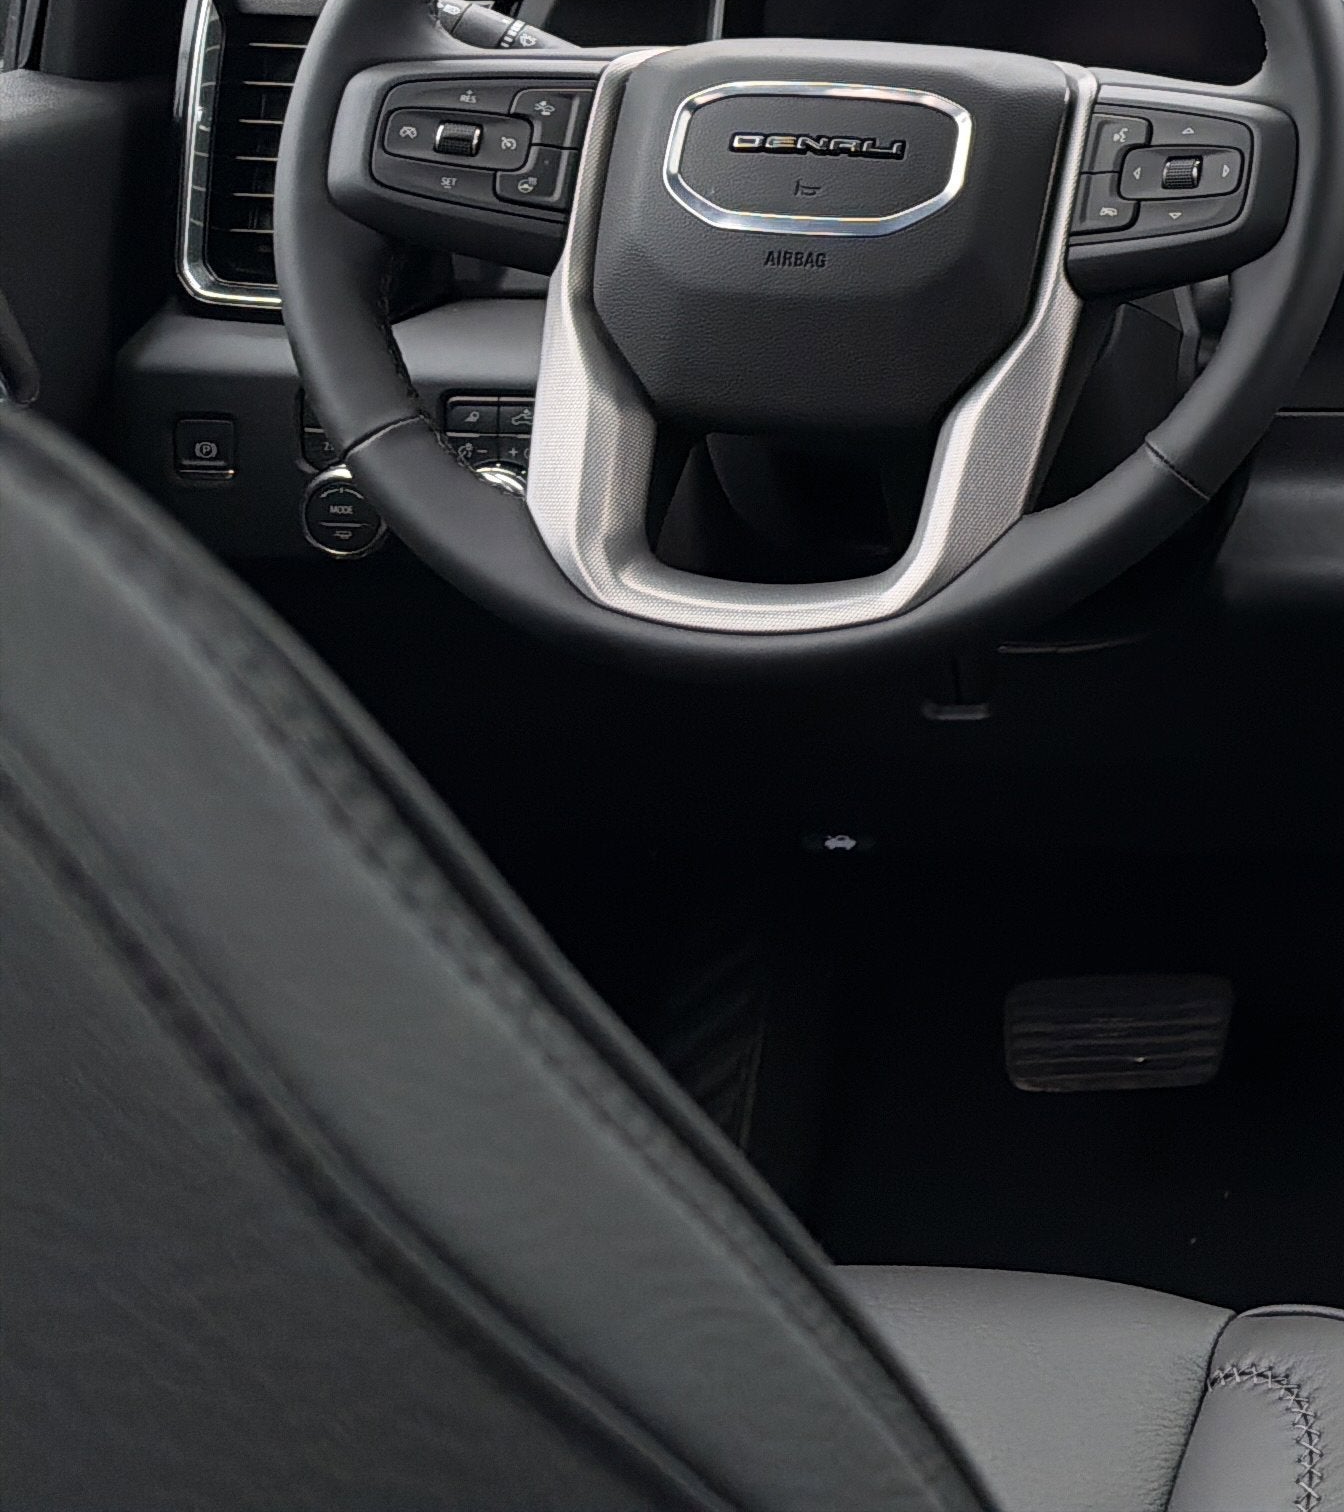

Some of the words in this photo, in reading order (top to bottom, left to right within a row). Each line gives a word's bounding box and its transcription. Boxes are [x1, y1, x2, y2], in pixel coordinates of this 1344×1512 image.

[459, 94, 477, 103] RES
[730, 132, 906, 160] DENALI
[440, 176, 457, 186] SET
[763, 250, 827, 268] AIRBAG
[329, 505, 354, 515] MODE
